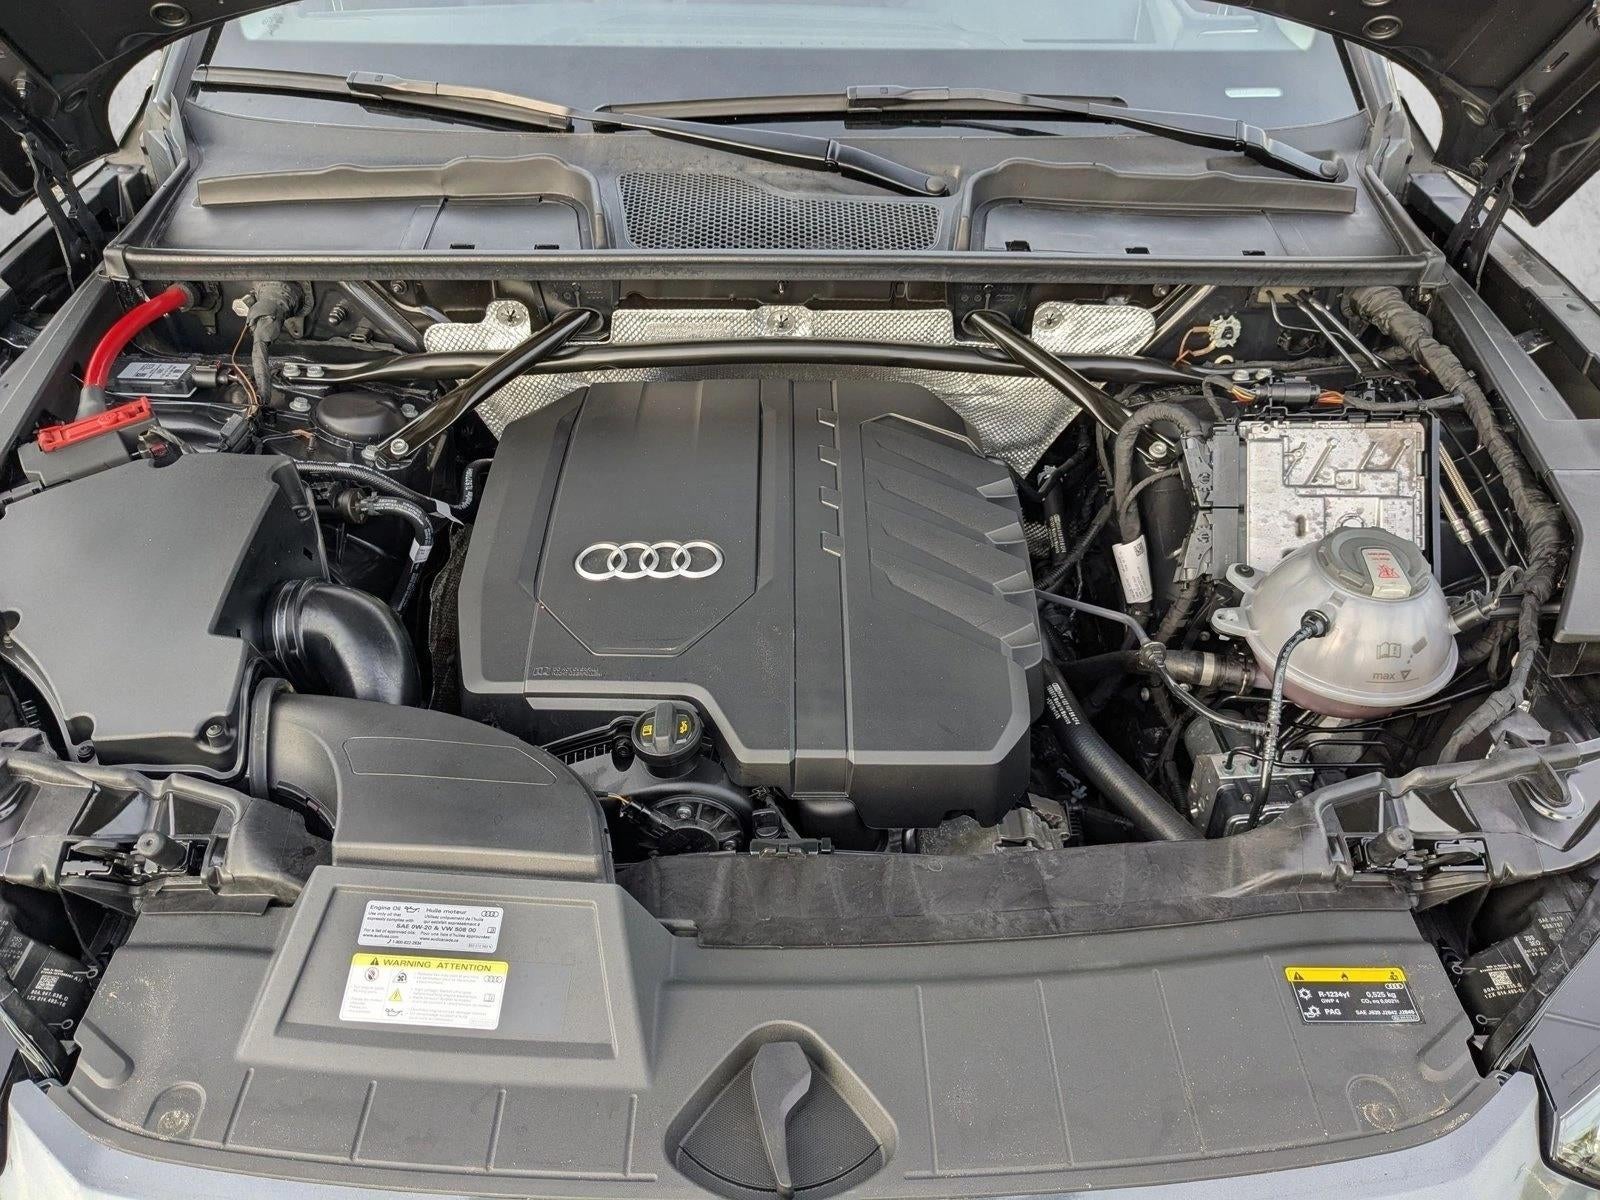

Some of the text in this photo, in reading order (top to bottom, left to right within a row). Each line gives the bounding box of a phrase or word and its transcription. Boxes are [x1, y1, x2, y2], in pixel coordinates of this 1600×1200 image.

[1372, 672, 1396, 680] max
[383, 959, 431, 968] WARNING
[436, 961, 492, 972] ATTENTION
[1318, 991, 1351, 999] R-1234yf
[1386, 991, 1397, 999] kg
